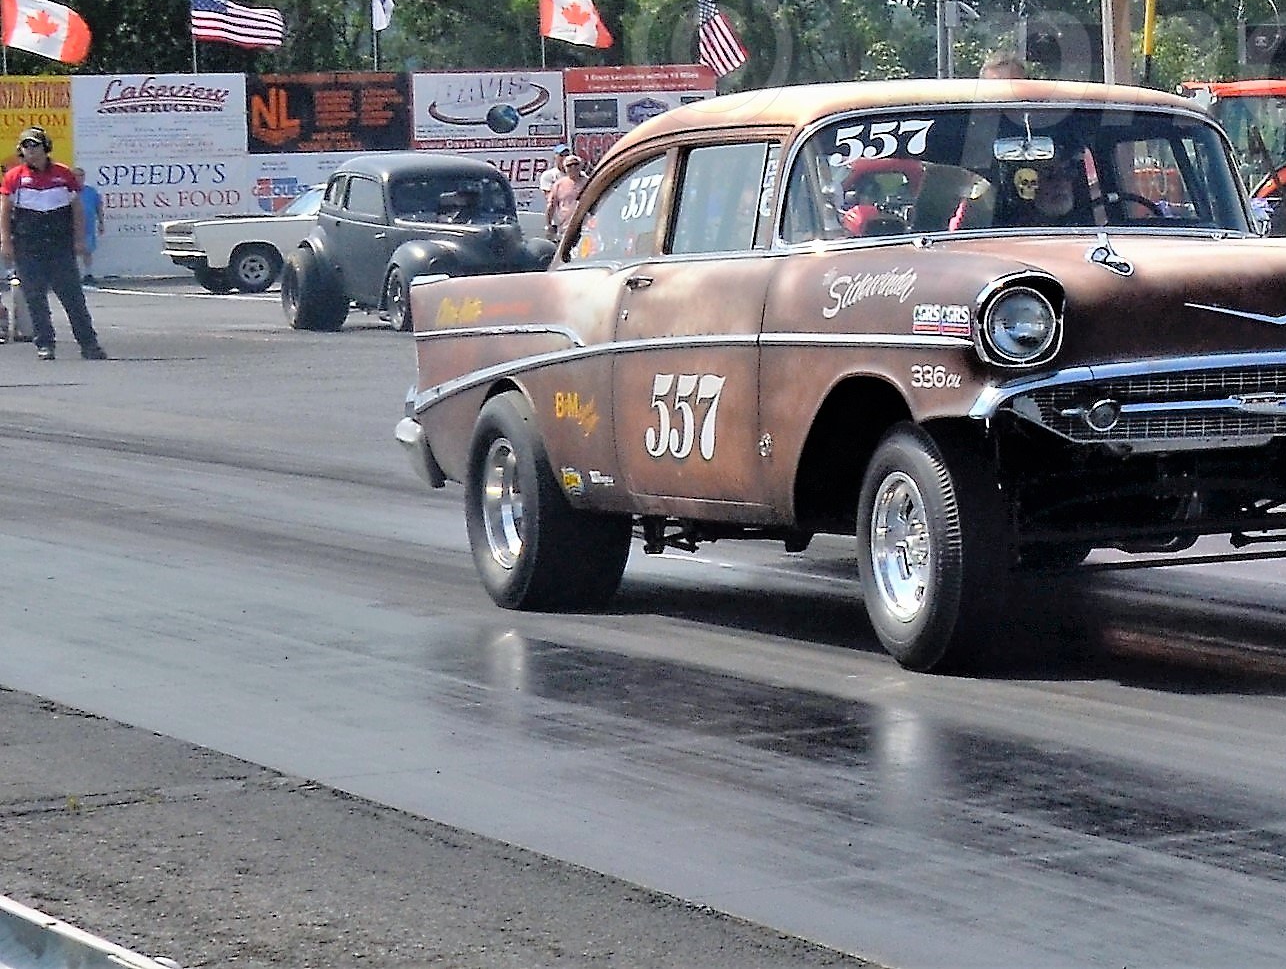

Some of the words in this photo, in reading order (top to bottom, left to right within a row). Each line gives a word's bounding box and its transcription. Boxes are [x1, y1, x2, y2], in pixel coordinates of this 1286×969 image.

[100, 76, 230, 105] Lakeview
[3, 113, 68, 127] USTOM
[96, 102, 225, 114] CONSTRUCTION
[829, 119, 935, 167] 557
[97, 163, 226, 187] SPEEDY'S
[106, 191, 147, 209] EER
[179, 189, 241, 207] FOOD
[620, 173, 665, 222] 557
[644, 372, 727, 462] 557
